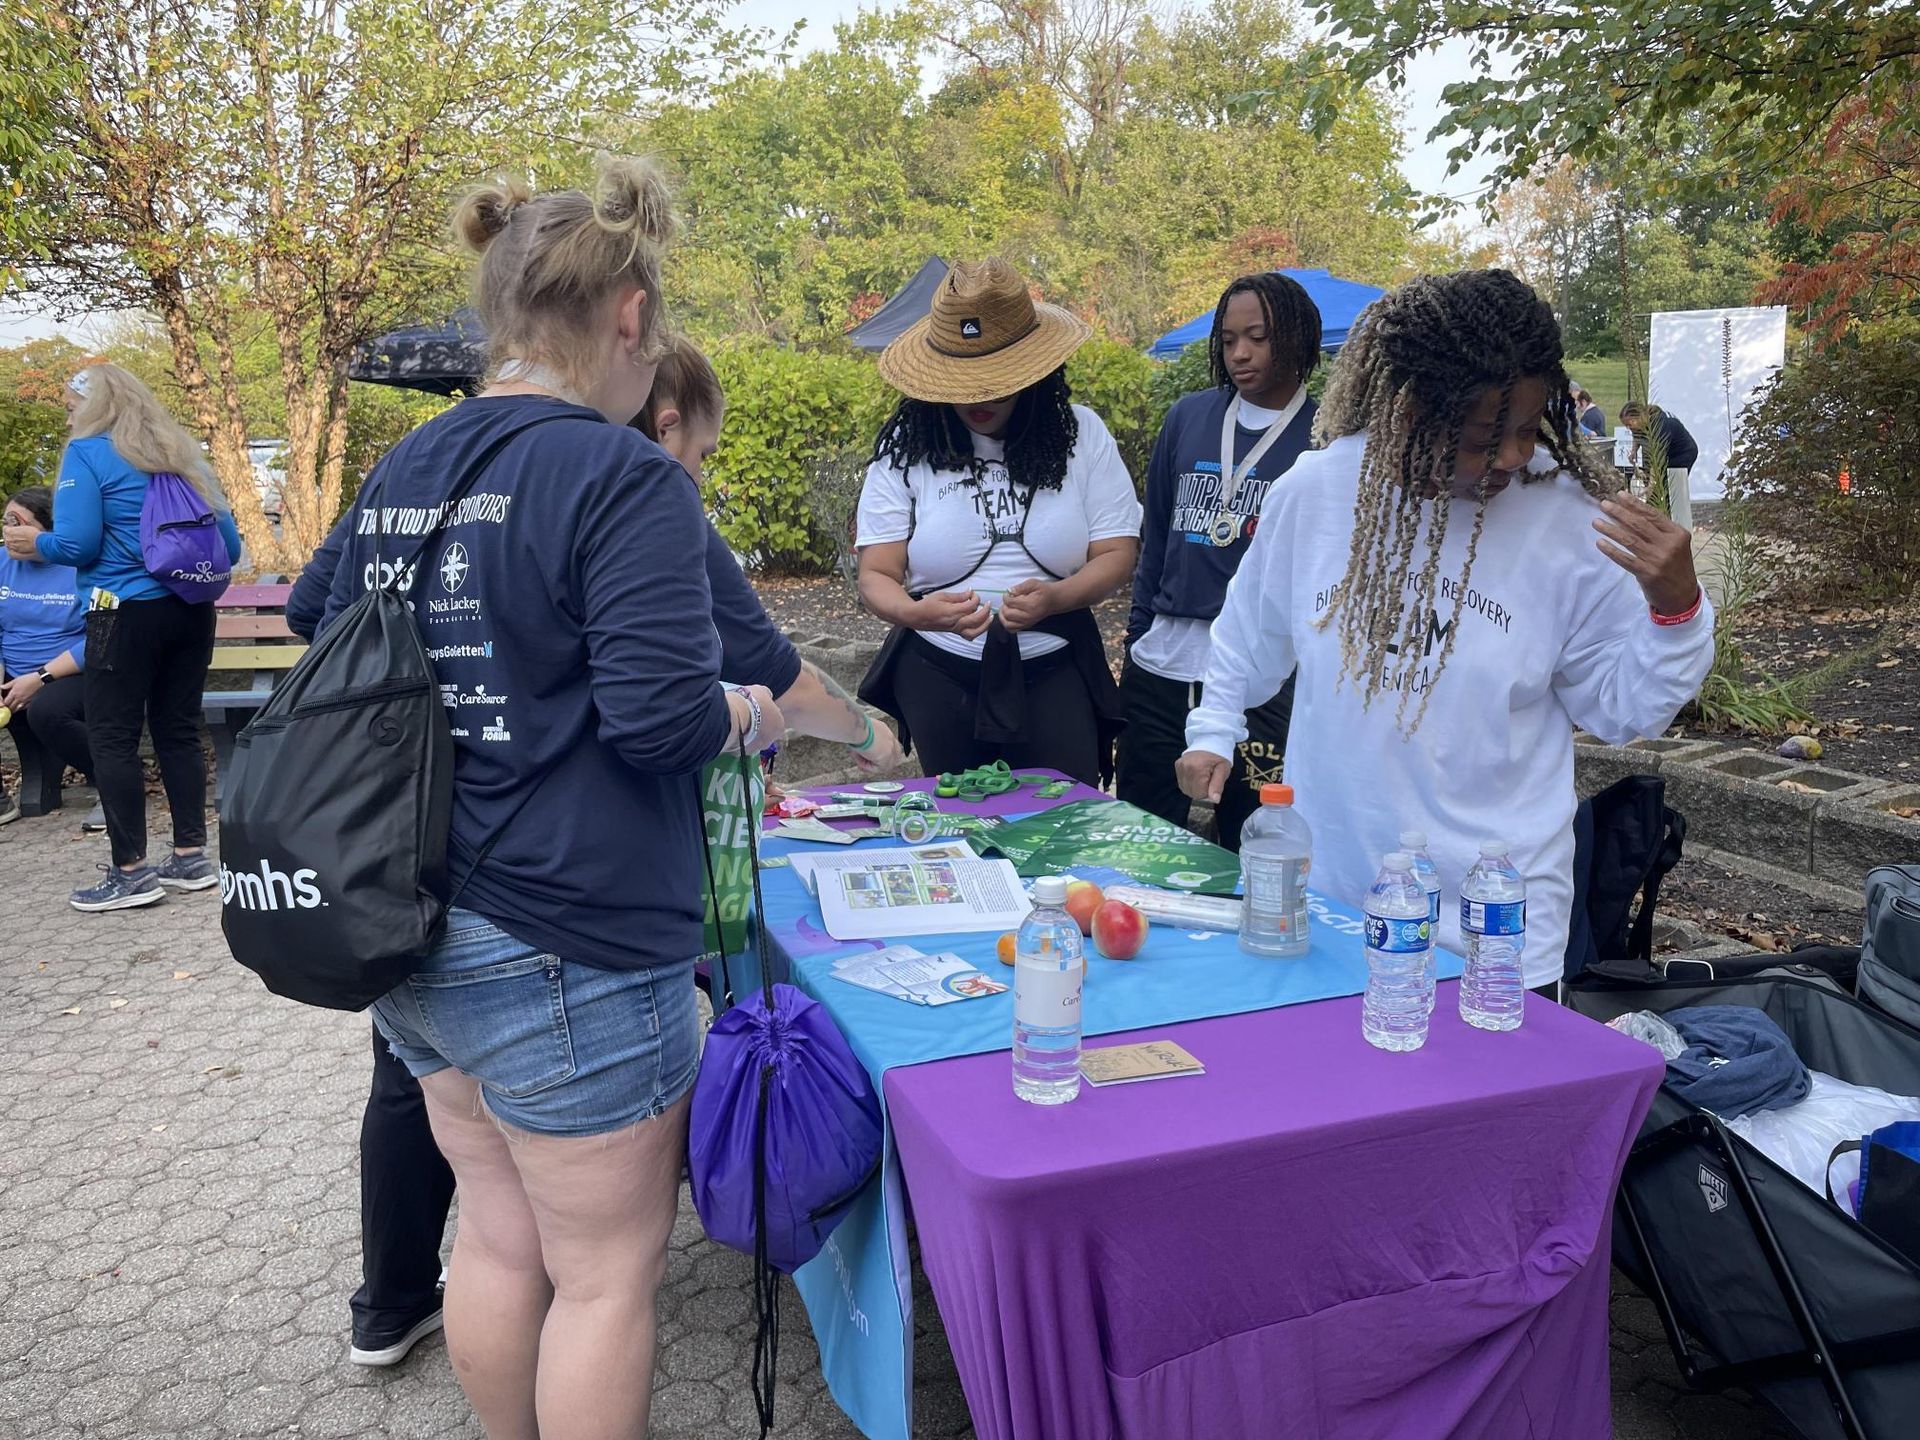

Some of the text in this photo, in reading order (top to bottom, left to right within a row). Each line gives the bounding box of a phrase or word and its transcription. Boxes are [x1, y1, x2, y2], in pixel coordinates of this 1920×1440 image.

[938, 481, 958, 500] BIRD
[1175, 473, 1271, 517] OUTPACIN
[971, 487, 1029, 520] TEAM
[395, 507, 427, 535] YOU
[429, 596, 481, 614] Nick Lackey
[460, 693, 506, 705] CareSource
[482, 731, 511, 741] FORUM
[1237, 741, 1285, 761] POL
[235, 859, 321, 910] mhs
[1701, 1168, 1726, 1198] QUEST
